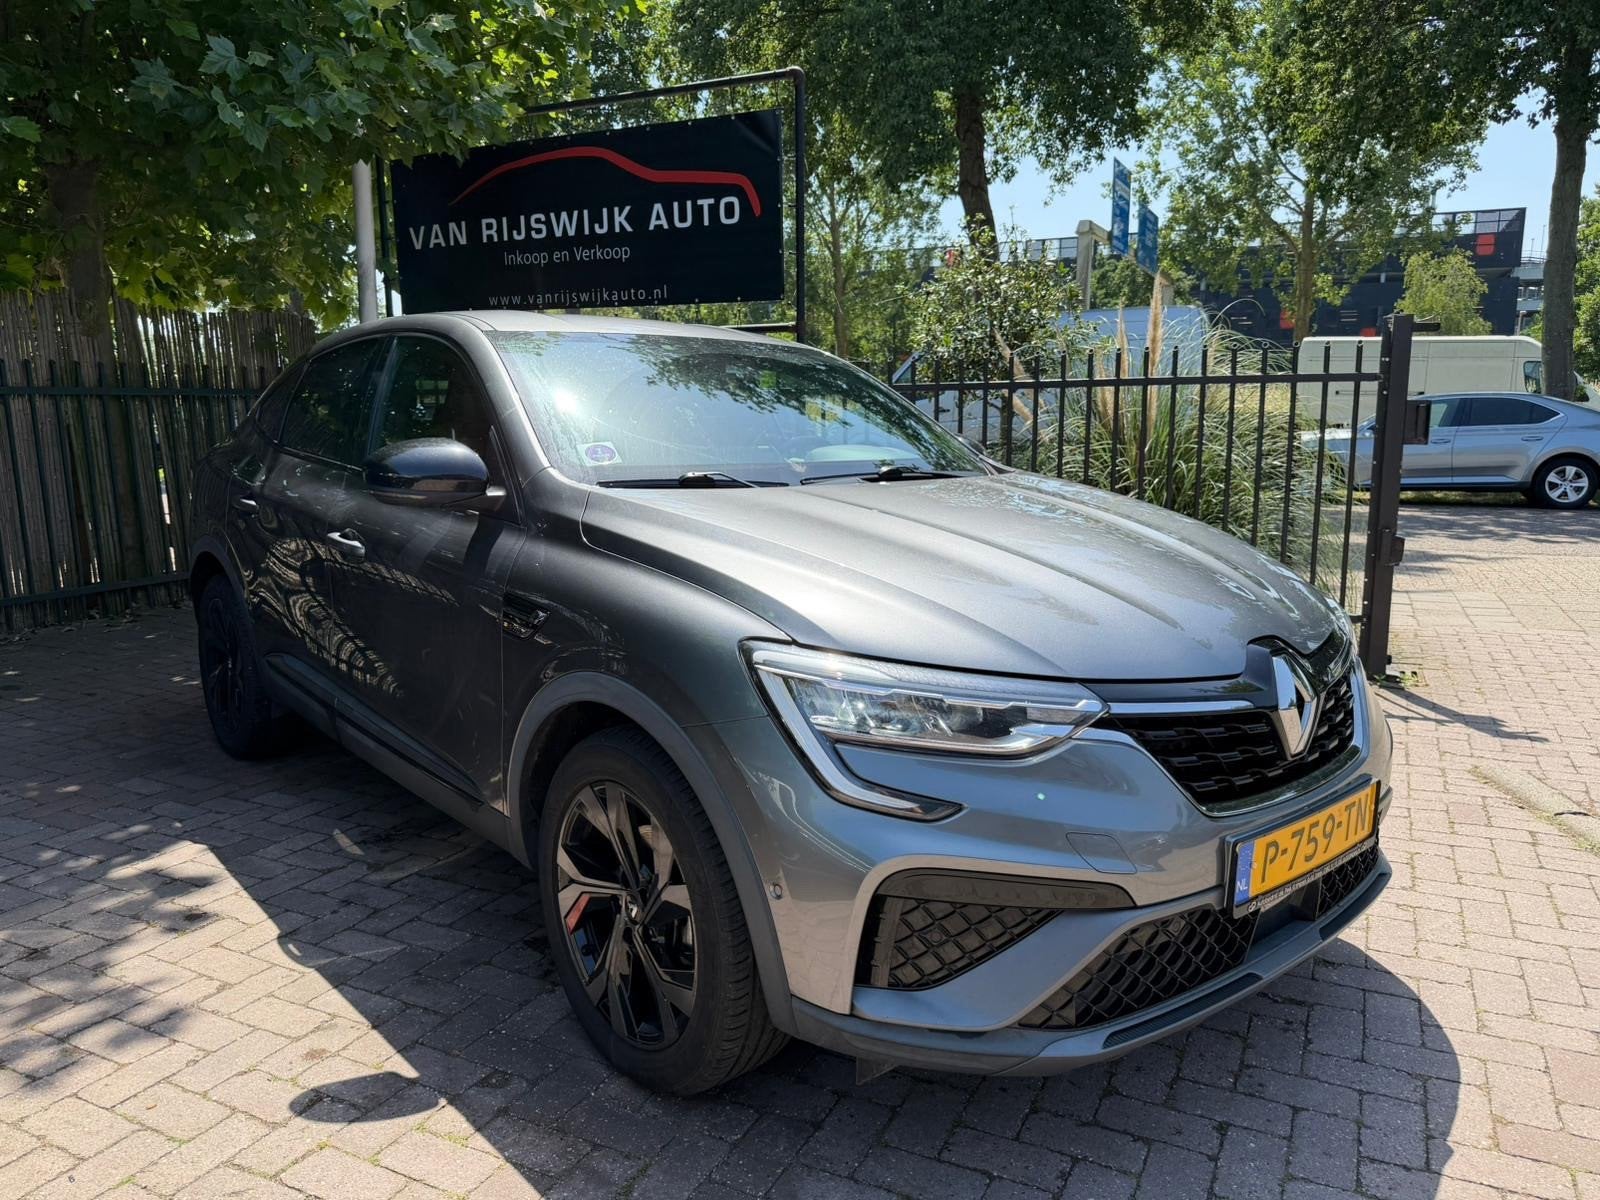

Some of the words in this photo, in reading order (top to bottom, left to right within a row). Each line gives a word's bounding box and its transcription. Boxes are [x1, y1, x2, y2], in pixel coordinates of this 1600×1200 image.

[409, 220, 467, 250] VAN
[481, 205, 633, 243] RIJSWIJK
[648, 196, 740, 231] AUTO
[504, 249, 549, 267] Inkoop
[553, 250, 569, 263] en
[574, 244, 631, 262] Verkoop
[488, 284, 668, 306] www.vanrijswijkauto.nl
[1261, 793, 1369, 884] P-759-TN
[1236, 878, 1249, 893] NL
